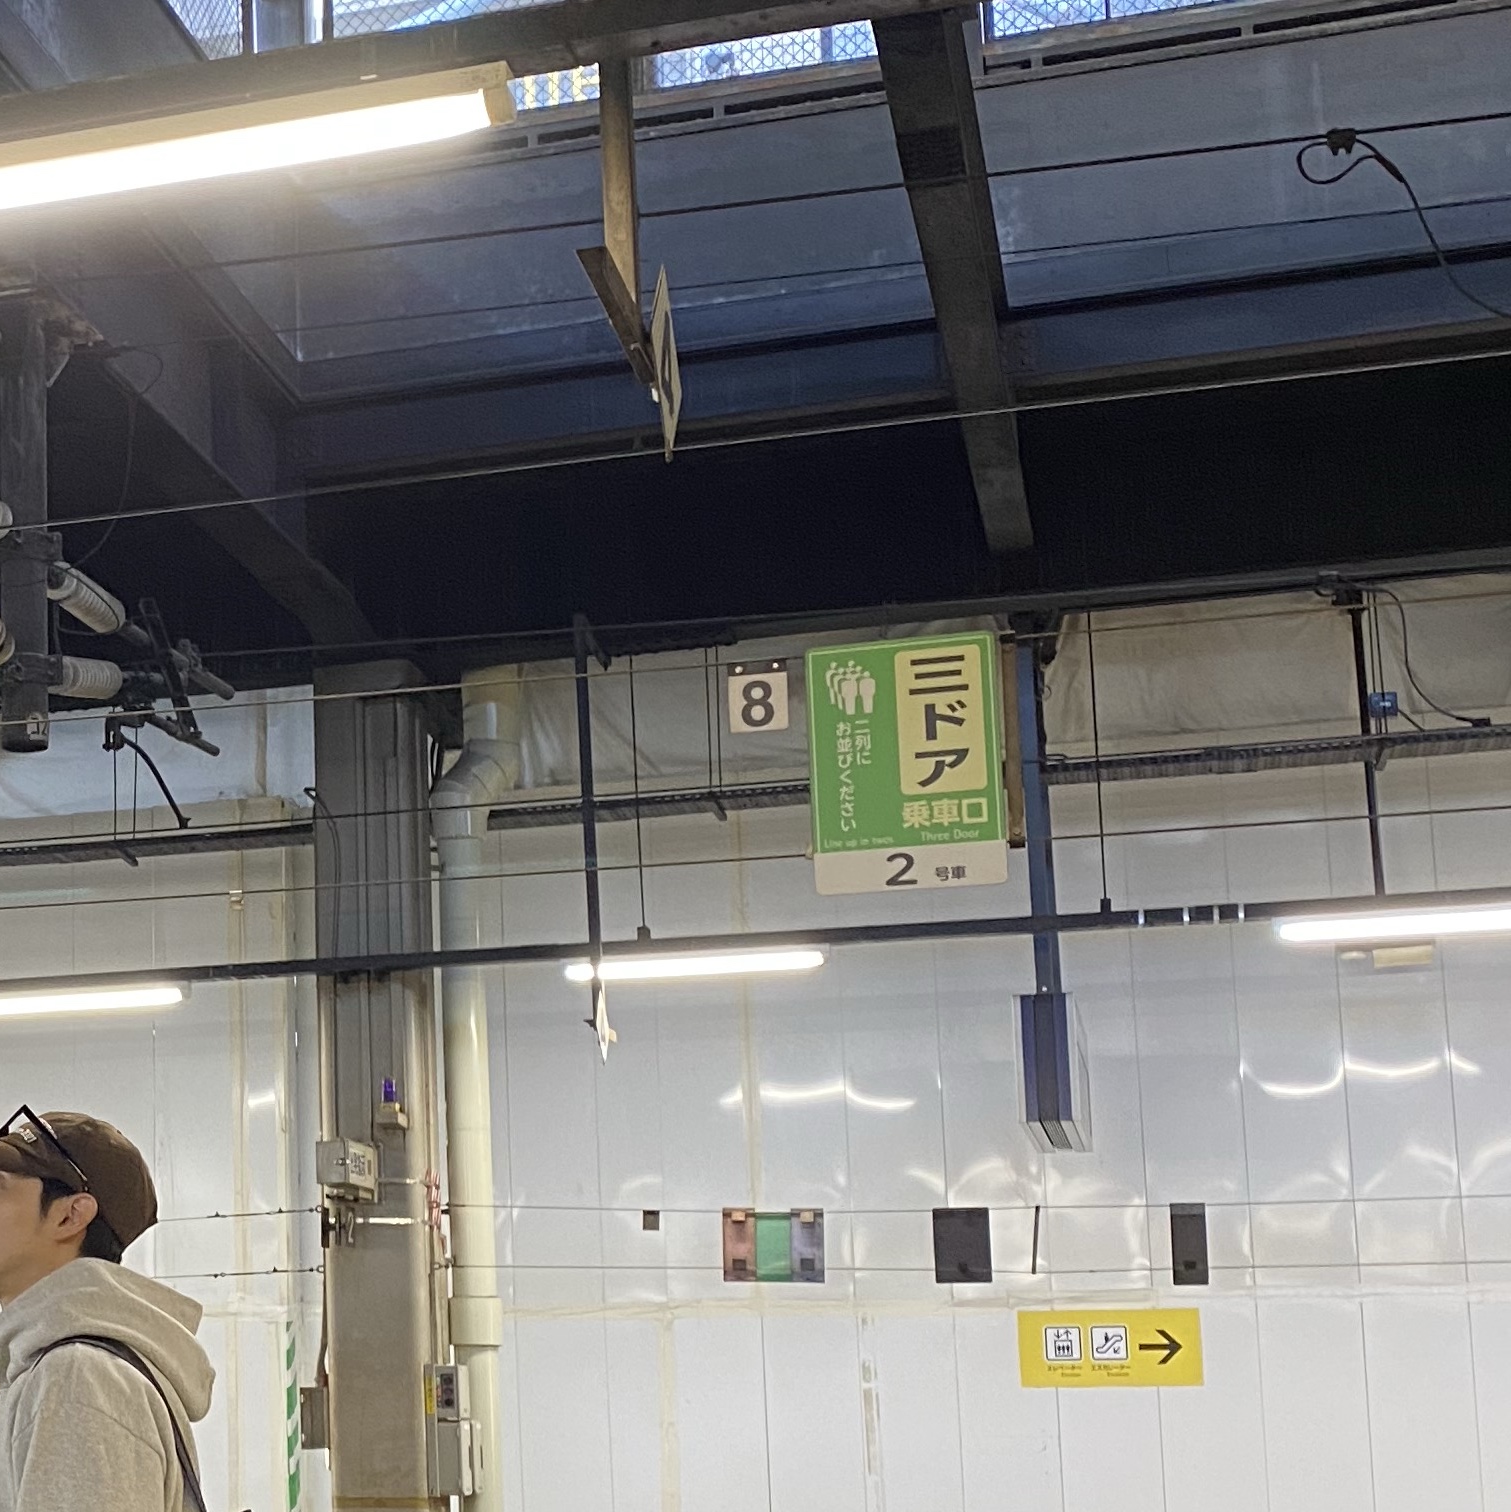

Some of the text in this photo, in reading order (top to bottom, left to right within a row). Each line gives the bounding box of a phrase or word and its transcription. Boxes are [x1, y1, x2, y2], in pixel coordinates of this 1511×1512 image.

[741, 680, 775, 728] 8
[908, 653, 970, 788] 三ドア
[854, 719, 872, 766] 二列に
[835, 721, 857, 832] お並びください
[901, 796, 989, 829] 乗車口
[920, 828, 980, 842] Three Door
[885, 852, 968, 887] 2 号車
